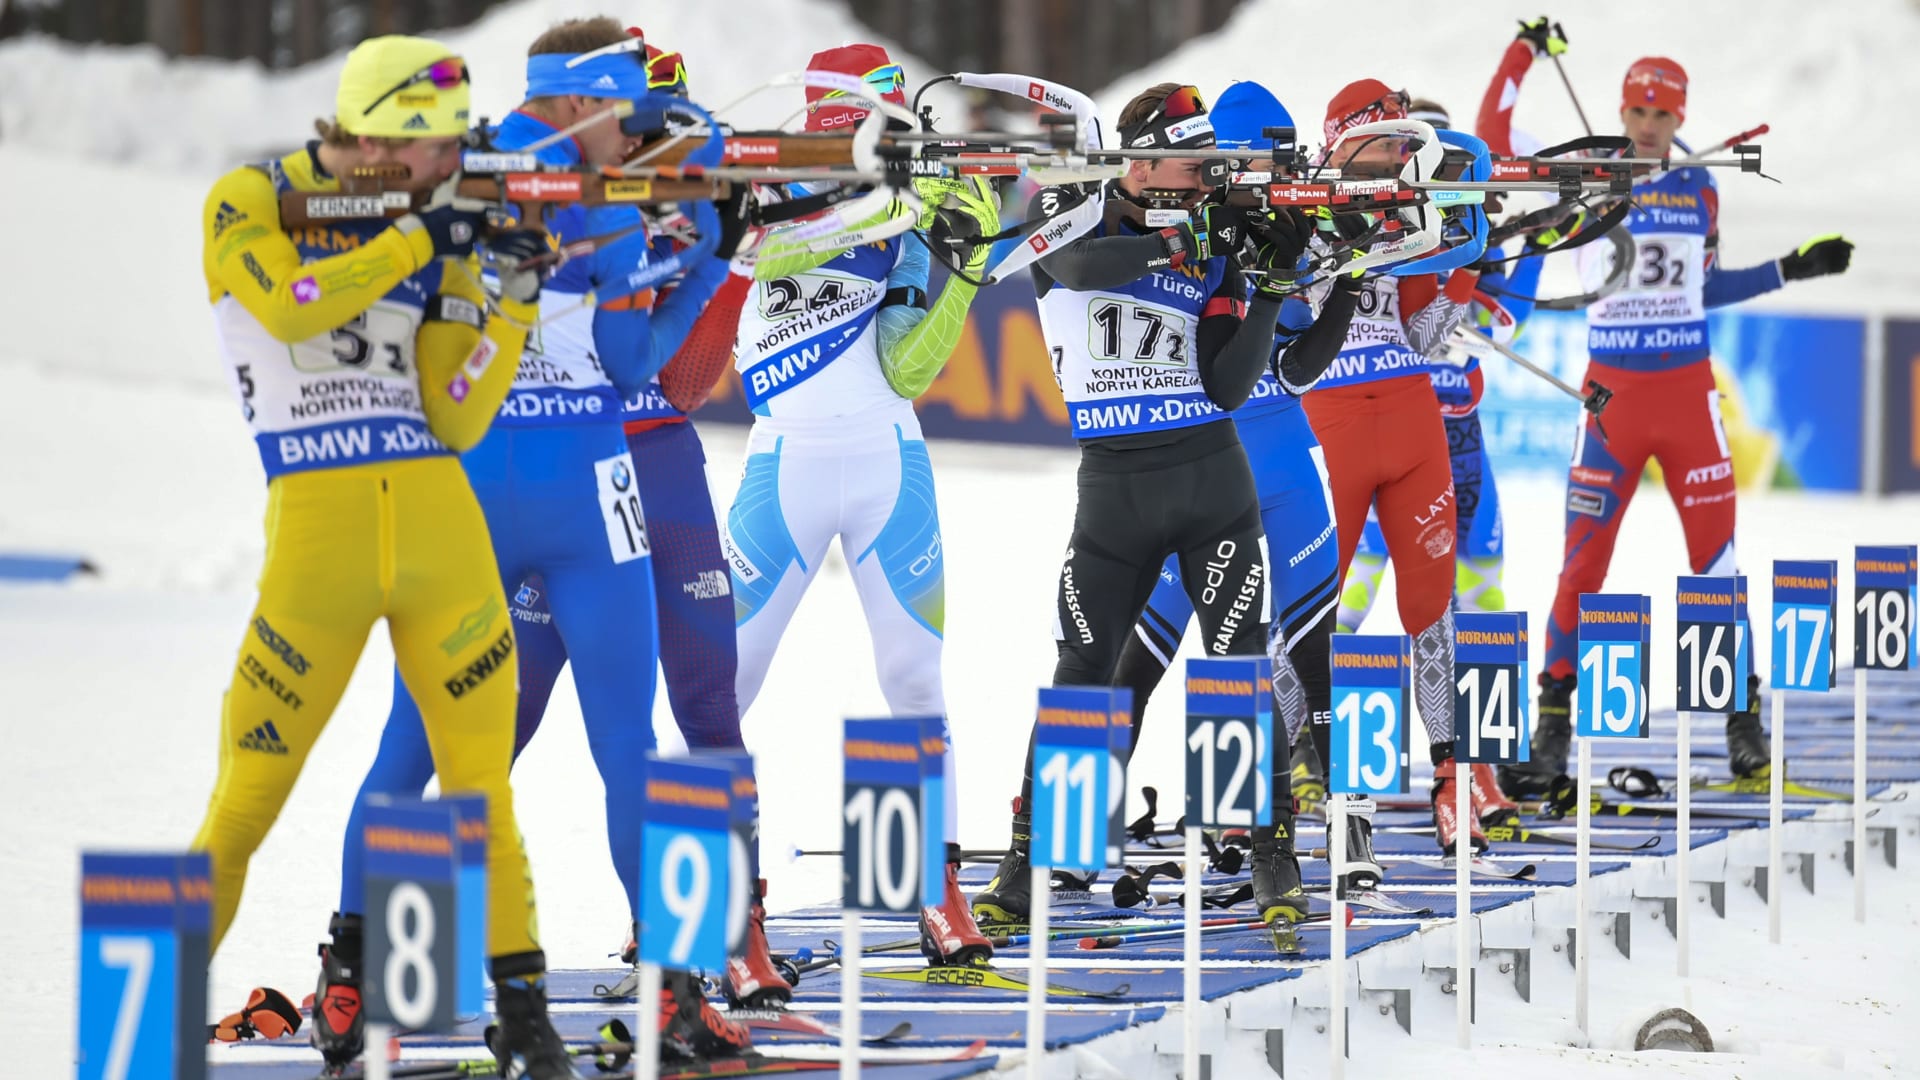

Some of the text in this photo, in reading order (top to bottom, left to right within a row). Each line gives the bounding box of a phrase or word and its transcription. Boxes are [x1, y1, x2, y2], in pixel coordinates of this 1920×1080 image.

[821, 111, 867, 127] odlo
[1045, 91, 1073, 111] triglav
[1272, 187, 1328, 201] VIESSMANN
[1652, 208, 1699, 226] Türen
[1044, 218, 1073, 243] triglav
[757, 320, 813, 353] NORTH
[816, 290, 878, 325] KARELIA
[1643, 327, 1702, 346] xDrive
[751, 343, 821, 397] BMW
[1087, 377, 1138, 395] NORTH
[291, 399, 363, 420] NORTH
[501, 393, 603, 419] xDrive
[1076, 404, 1141, 431] BMW
[278, 426, 371, 465] BMW
[684, 580, 717, 594] NORTH
[694, 588, 722, 601] FACE
[698, 571, 717, 582] THE
[1202, 539, 1237, 605] odlo
[1062, 565, 1095, 645] swisscom
[1212, 563, 1263, 656] RAIFFEISEN
[1856, 590, 1907, 669] 18
[1679, 624, 1733, 710] 16
[1775, 607, 1827, 687] 17
[1456, 667, 1517, 760] 14
[1580, 644, 1637, 733] 15
[1335, 690, 1397, 791] 13
[1187, 719, 1254, 826] 12
[1038, 752, 1098, 864] 11
[845, 786, 921, 911] 10
[660, 833, 712, 964] 9
[384, 880, 438, 1029] 8
[926, 967, 985, 986] FISCHER
[100, 935, 155, 1080] 7
